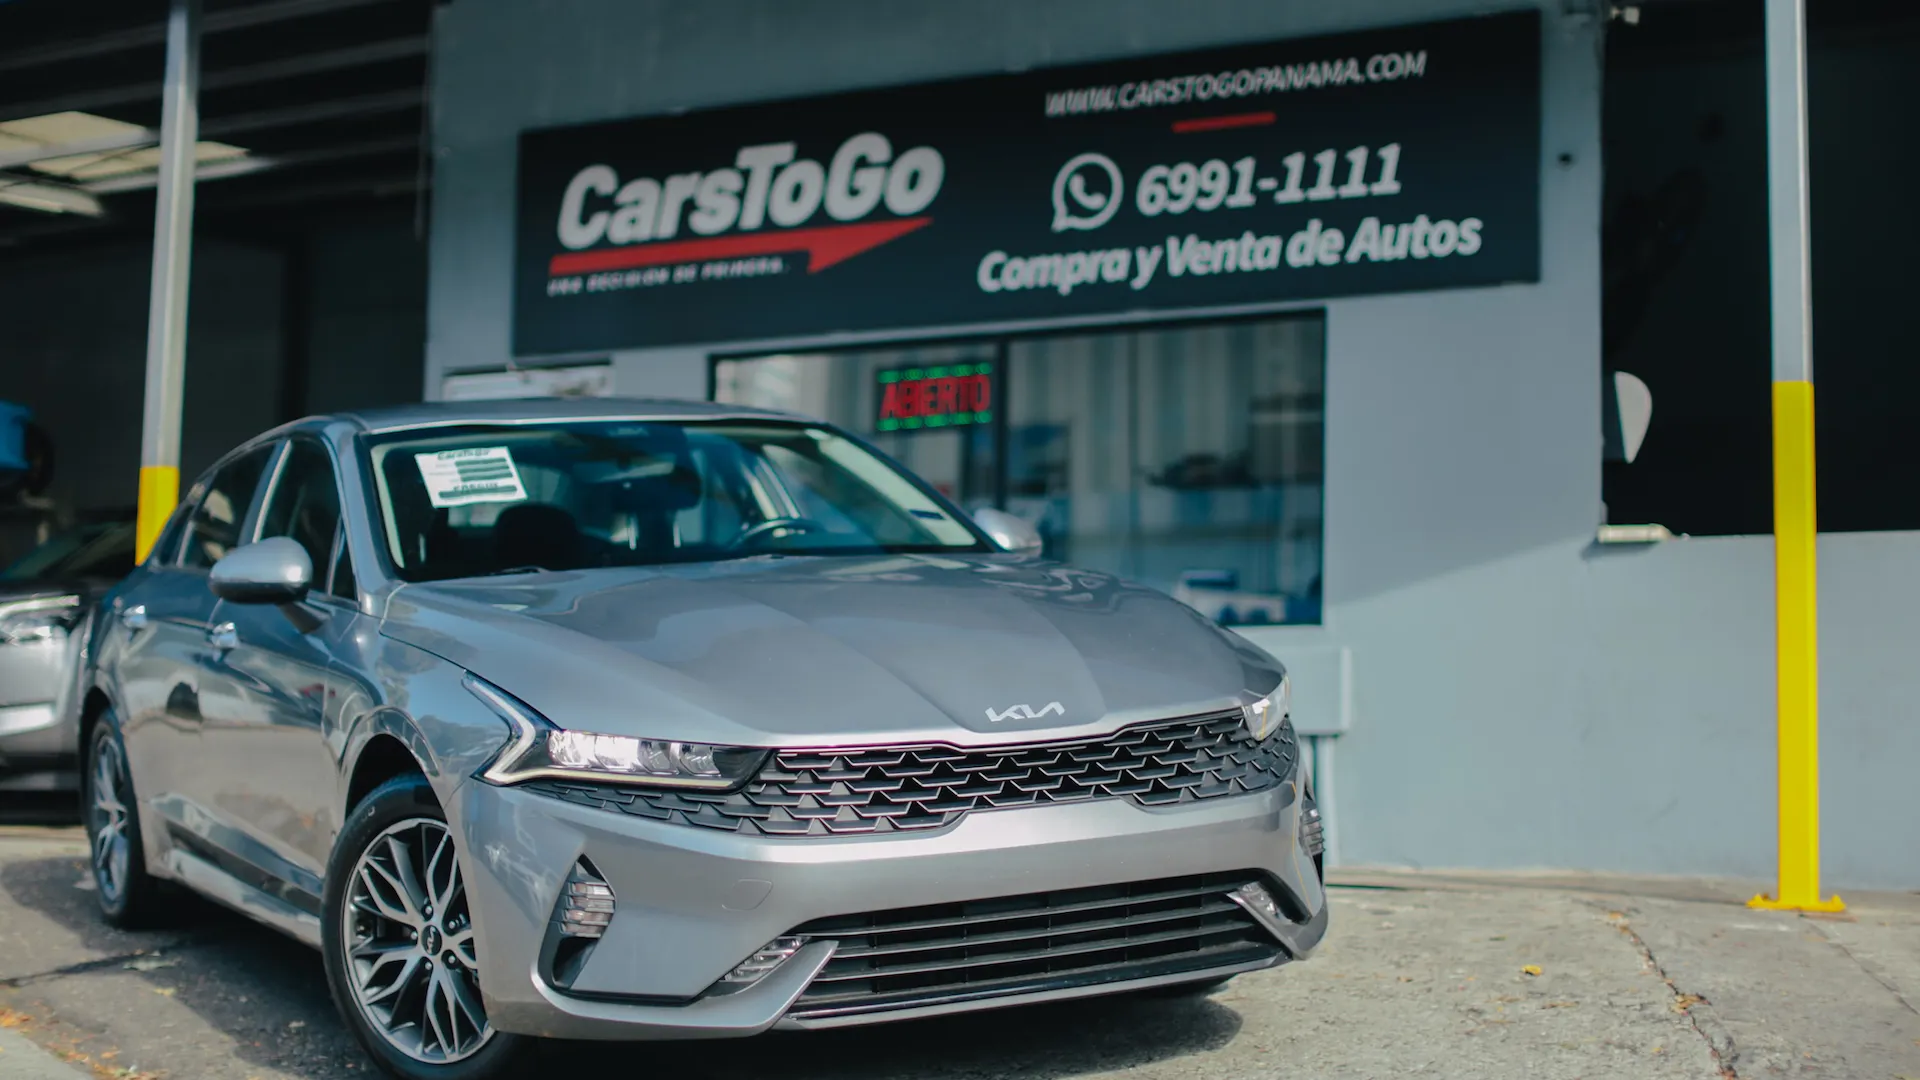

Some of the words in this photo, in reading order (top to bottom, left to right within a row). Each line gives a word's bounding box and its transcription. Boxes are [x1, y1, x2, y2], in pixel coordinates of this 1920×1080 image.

[1045, 51, 1427, 116] WWW.CARSTOGOPANAMA.COM
[557, 132, 945, 249] CarsToGo
[1136, 143, 1402, 216] 6991-1111
[977, 245, 1129, 296] Compra
[1130, 245, 1163, 290] y
[1166, 231, 1282, 276] Venta
[1285, 218, 1346, 269] de
[1345, 213, 1484, 264] Autos
